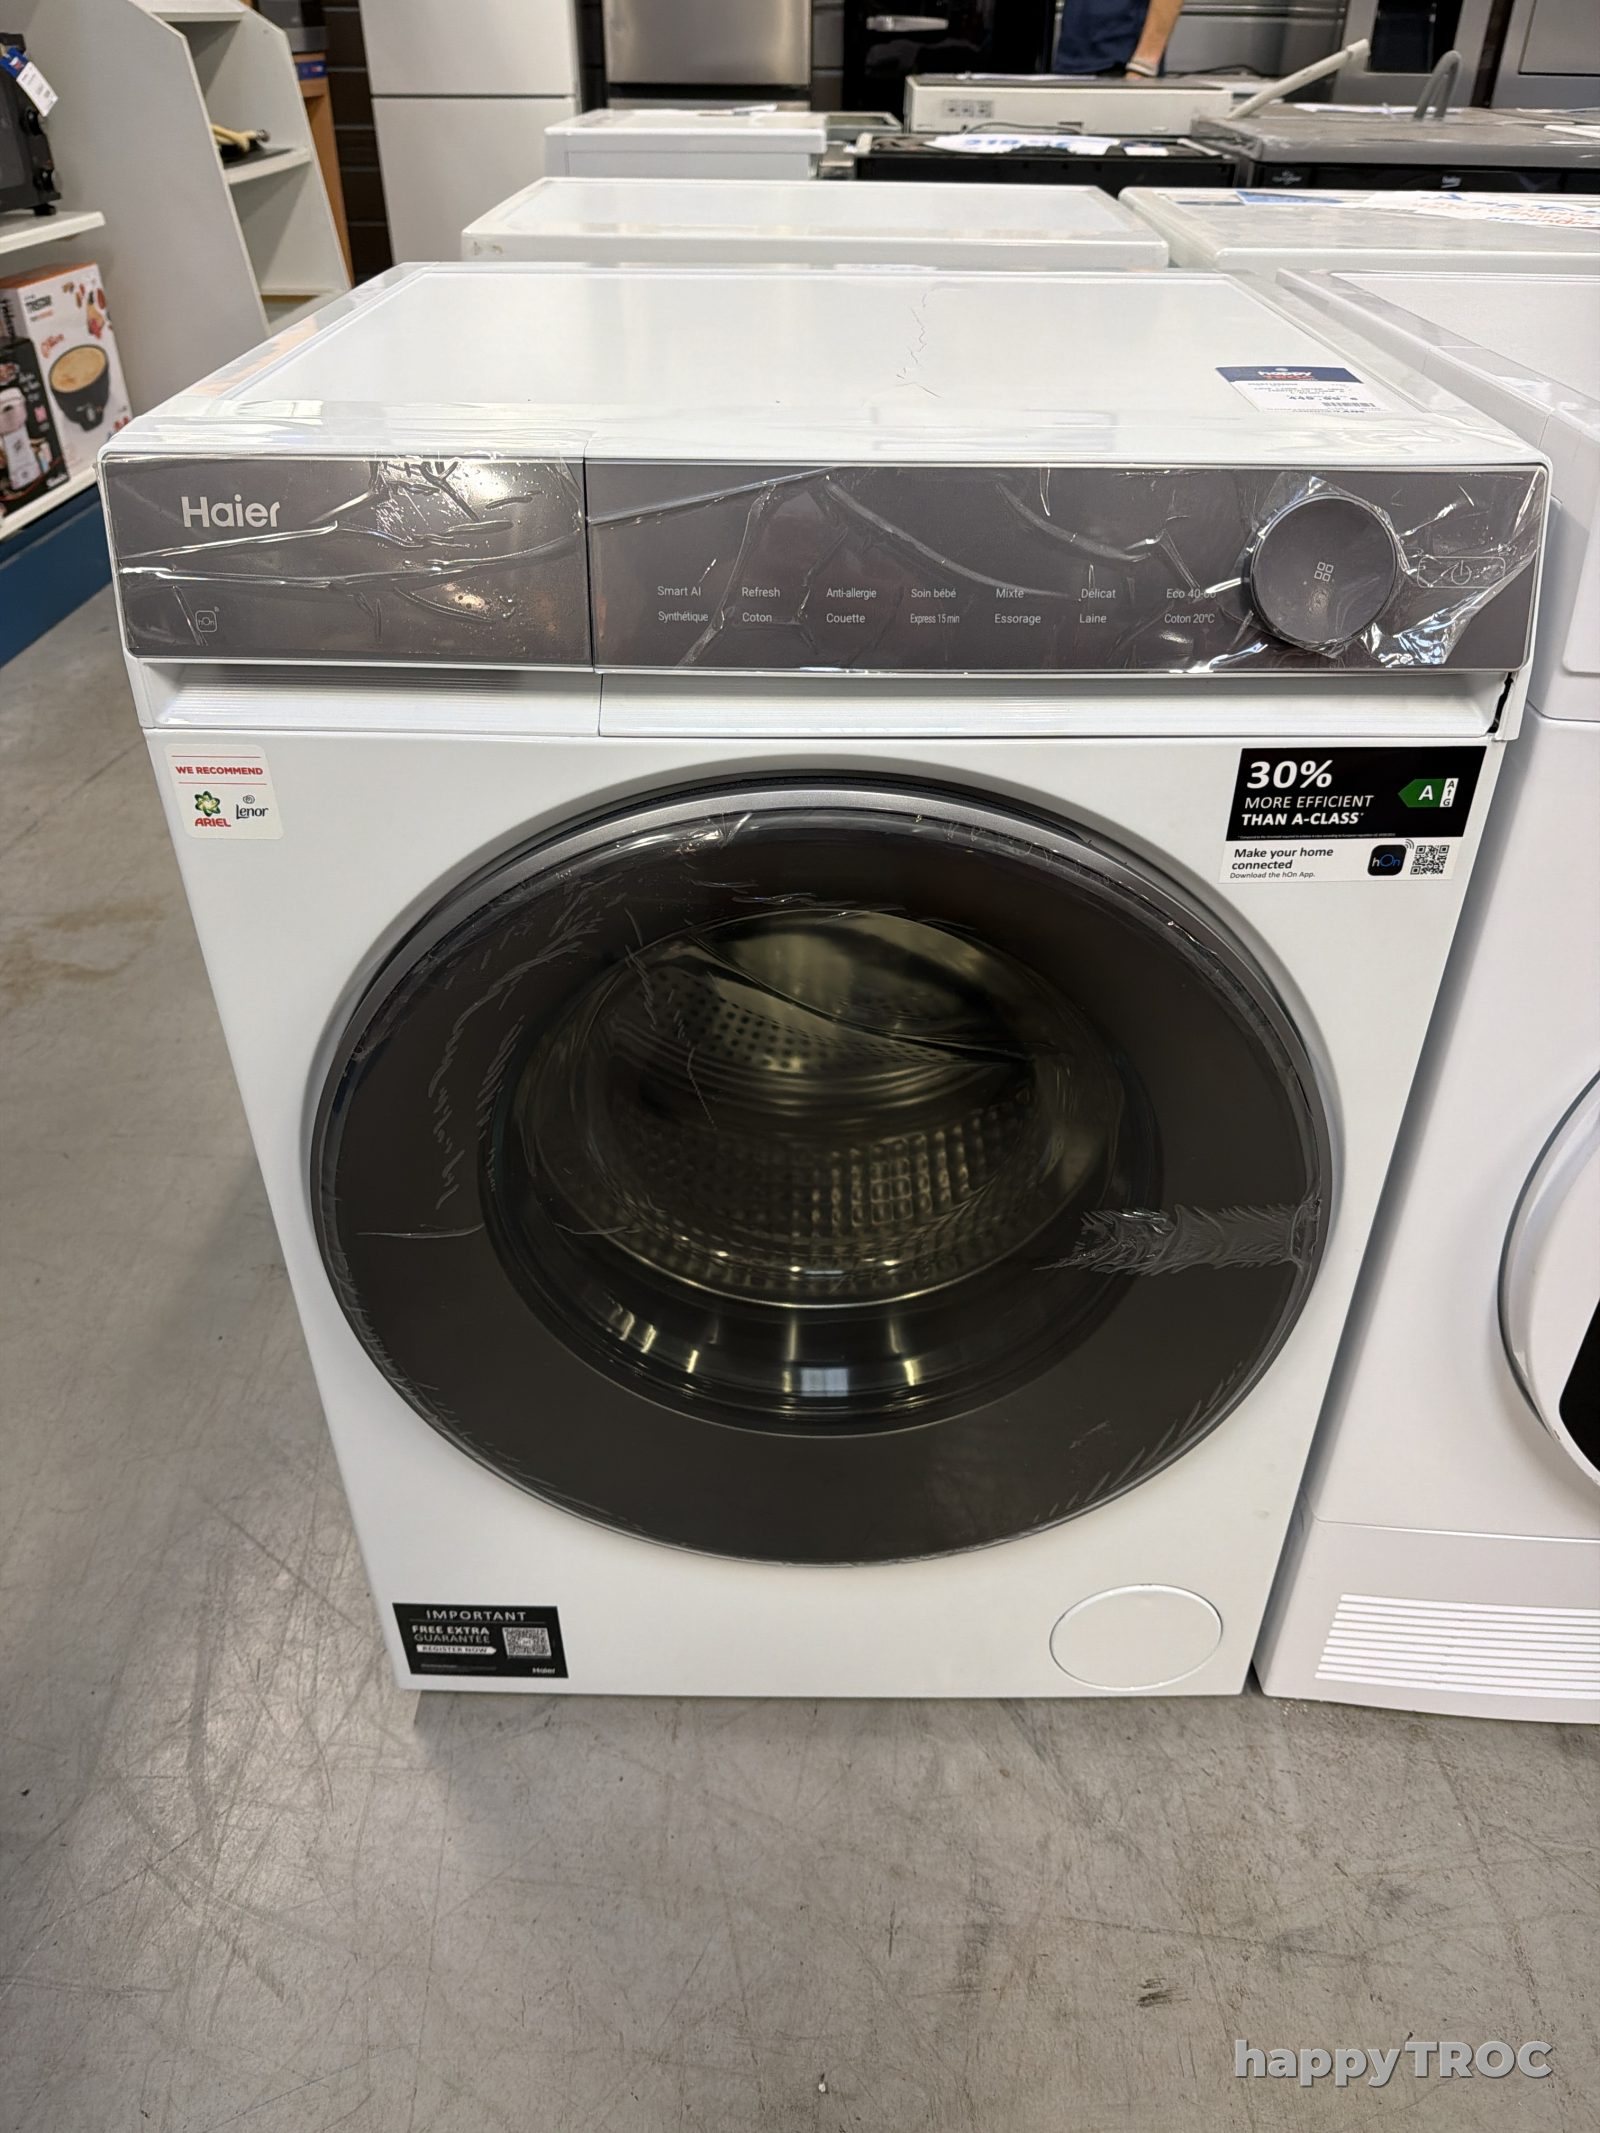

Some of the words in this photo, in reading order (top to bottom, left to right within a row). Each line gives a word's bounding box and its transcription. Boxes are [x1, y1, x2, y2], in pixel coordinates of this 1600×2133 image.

[181, 494, 280, 528] Haier
[657, 586, 688, 597] Smart
[690, 586, 702, 597] AI
[741, 586, 781, 598] Refresh
[826, 587, 877, 601] Anti-allergie
[910, 588, 932, 599] Soin
[933, 587, 957, 599] bébé
[995, 588, 1025, 600] Mixte
[1166, 588, 1186, 599] Eco
[657, 611, 709, 625] Synthétique
[741, 612, 773, 624] Coton
[826, 613, 866, 624] Couette
[909, 613, 936, 626] Express
[994, 613, 1042, 626] Essorage
[1079, 613, 1107, 624] Laine
[1164, 613, 1192, 624] Coton
[1192, 613, 1216, 624] 20°C
[175, 766, 194, 775] WE
[195, 766, 264, 776] RECOMMEND
[1246, 760, 1334, 790] 30%
[1446, 780, 1456, 789] A
[1418, 785, 1435, 801] A
[1244, 796, 1292, 810] MORE
[1297, 795, 1375, 809] EFFICIENT
[236, 804, 269, 820] Lenor
[195, 818, 232, 828] ARIEL
[1241, 813, 1288, 827] THAN
[1234, 848, 1268, 859] Make
[1269, 849, 1297, 862] your
[1299, 847, 1334, 858] home
[1372, 853, 1401, 868] hOn
[1232, 860, 1293, 871] connected
[1230, 871, 1267, 880] Download
[1268, 871, 1281, 879] the
[1299, 871, 1316, 880] App.
[426, 1610, 527, 1622] IMPORTANT
[412, 1625, 444, 1635] FREE
[447, 1626, 490, 1635] EXTRA
[414, 1634, 491, 1644] GUARANTEE
